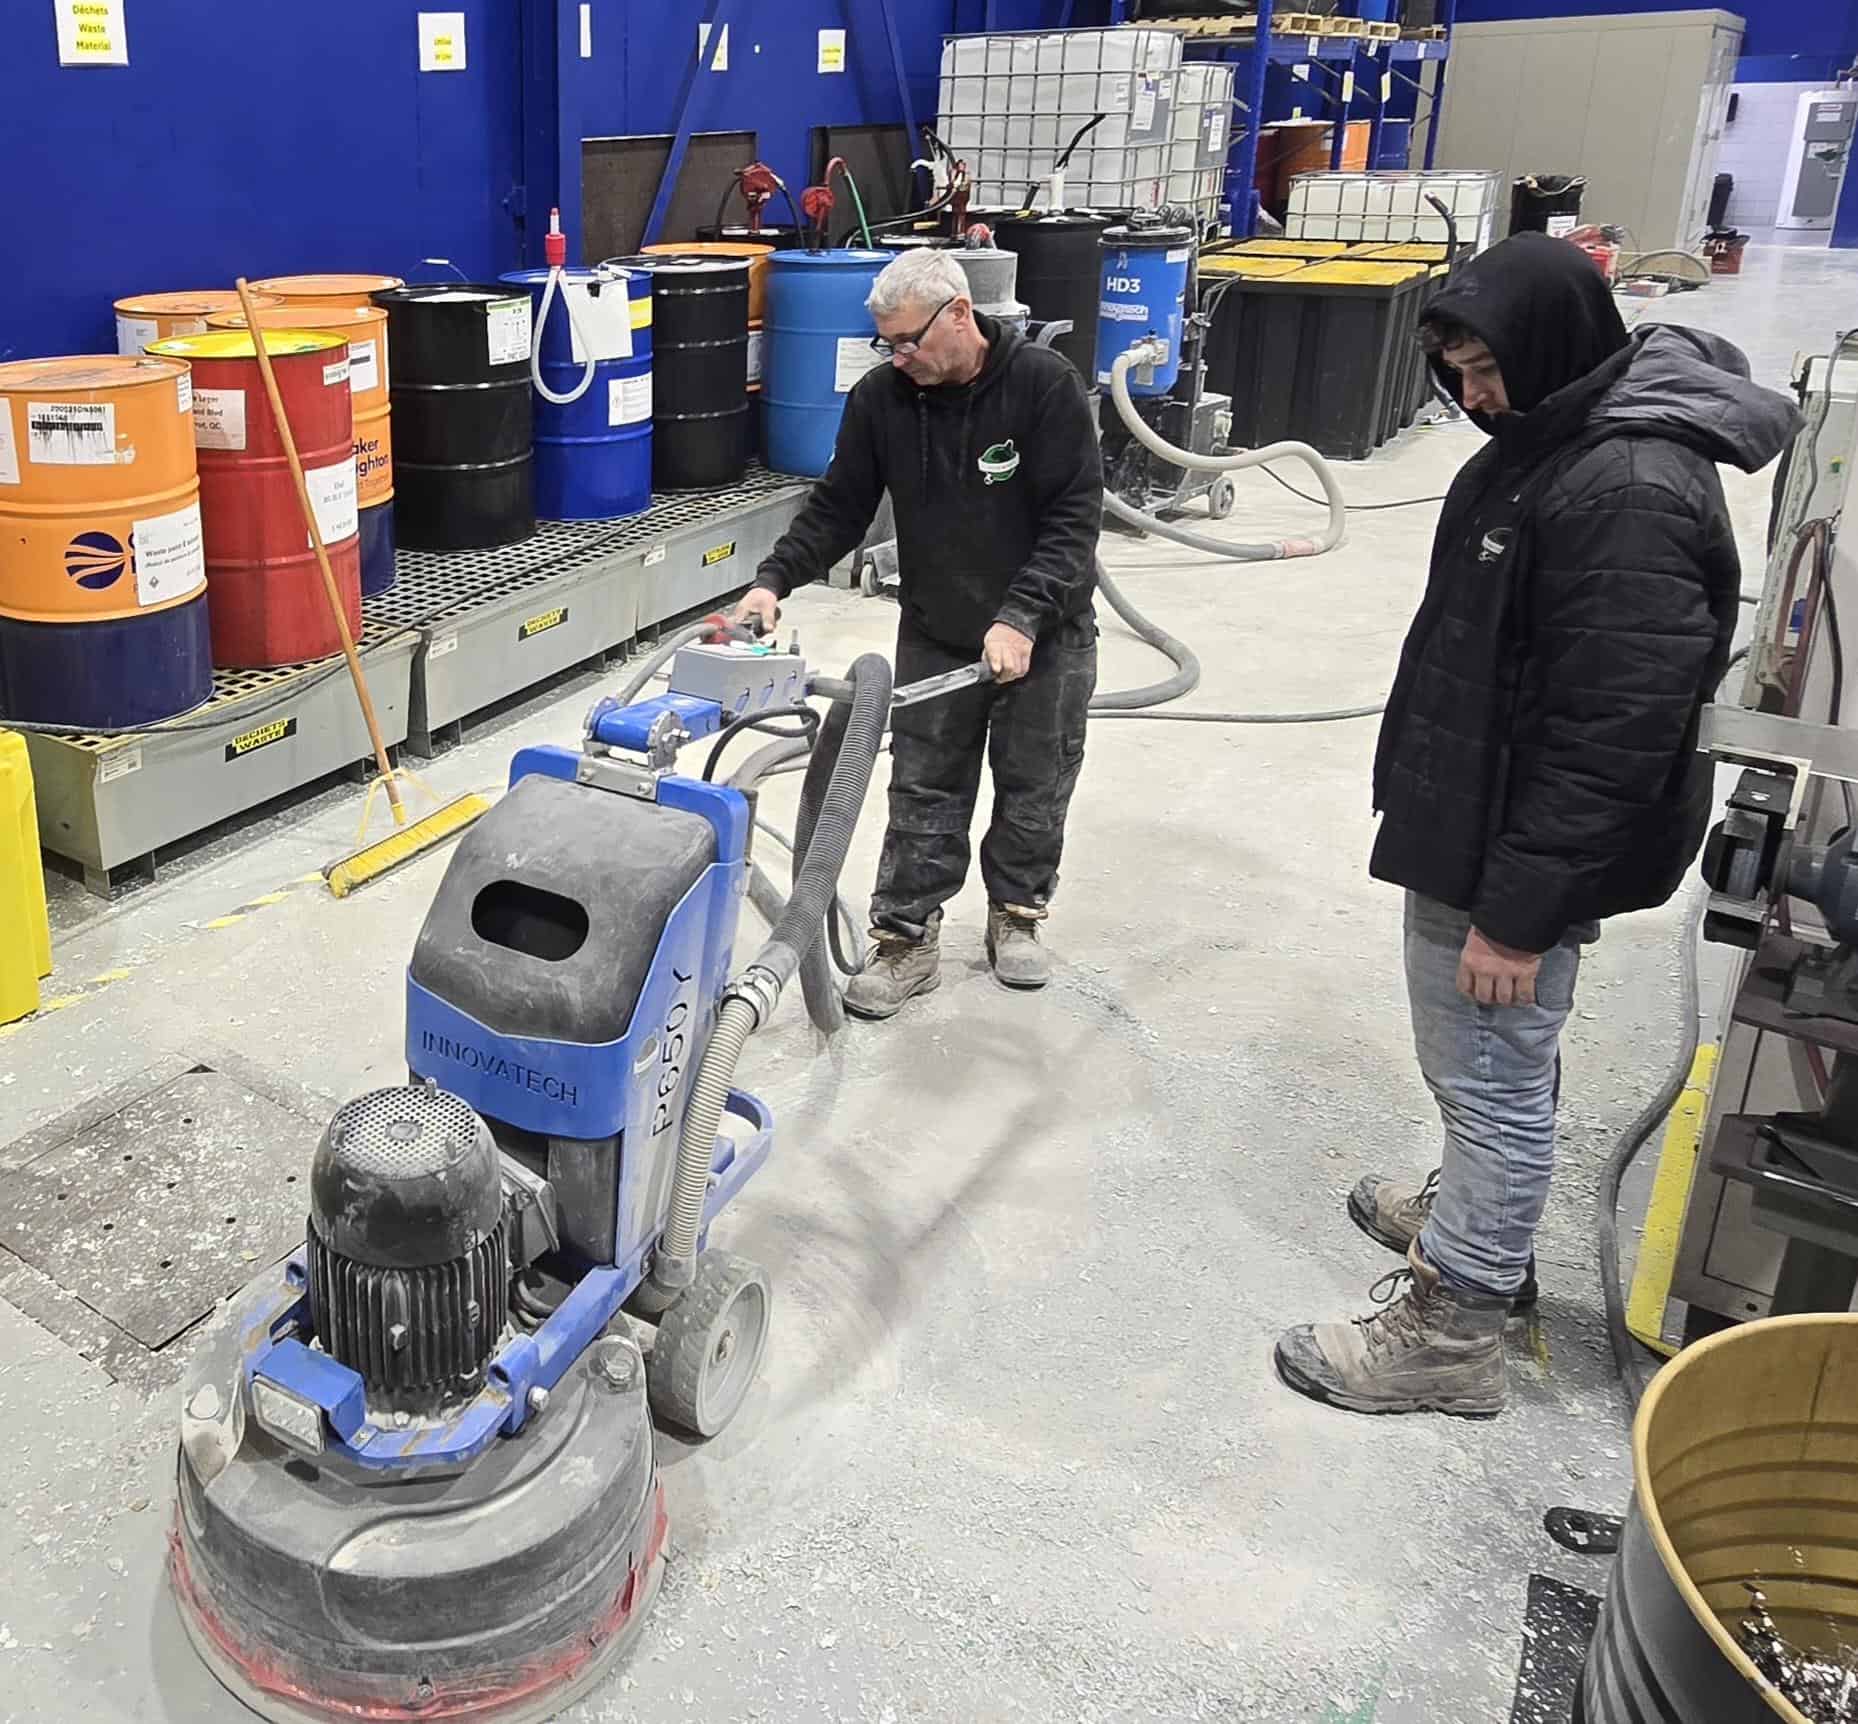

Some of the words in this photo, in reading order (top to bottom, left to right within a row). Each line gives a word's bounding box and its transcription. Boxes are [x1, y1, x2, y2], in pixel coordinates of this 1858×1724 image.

[72, 4, 109, 15] Déchets
[79, 24, 106, 34] Waste
[76, 40, 112, 50] Material
[1106, 276, 1141, 294] HD3
[207, 408, 224, 417] Blvd
[238, 730, 282, 751] WASTE
[423, 1030, 578, 1107] INNOVATECH
